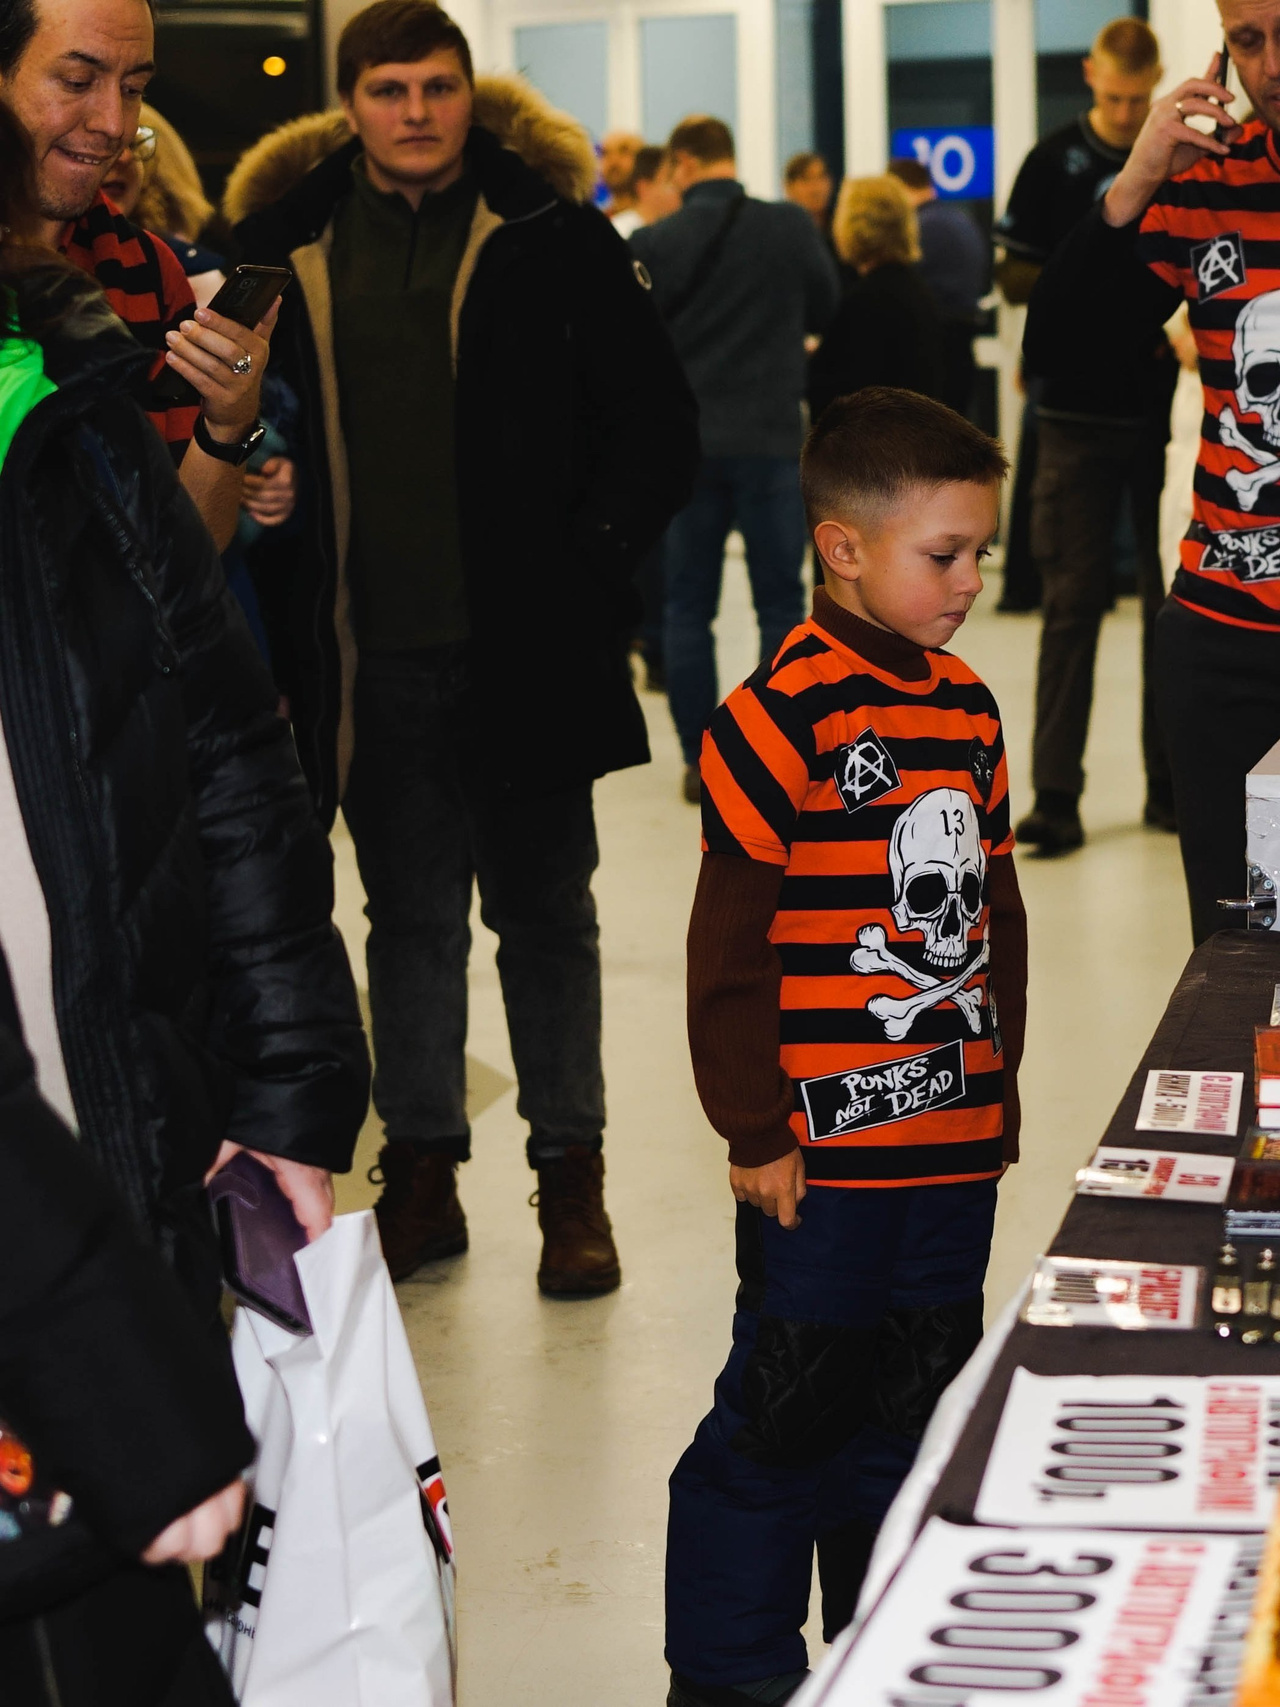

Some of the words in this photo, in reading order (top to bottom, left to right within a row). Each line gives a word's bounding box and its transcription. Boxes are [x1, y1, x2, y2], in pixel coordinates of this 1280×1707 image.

[913, 135, 975, 192] 10
[940, 809, 966, 837] 13
[834, 1098, 872, 1126] NOT
[884, 1069, 955, 1115] DEAD
[845, 1056, 930, 1104] PUNKS
[1155, 1073, 1192, 1098] КНИГА
